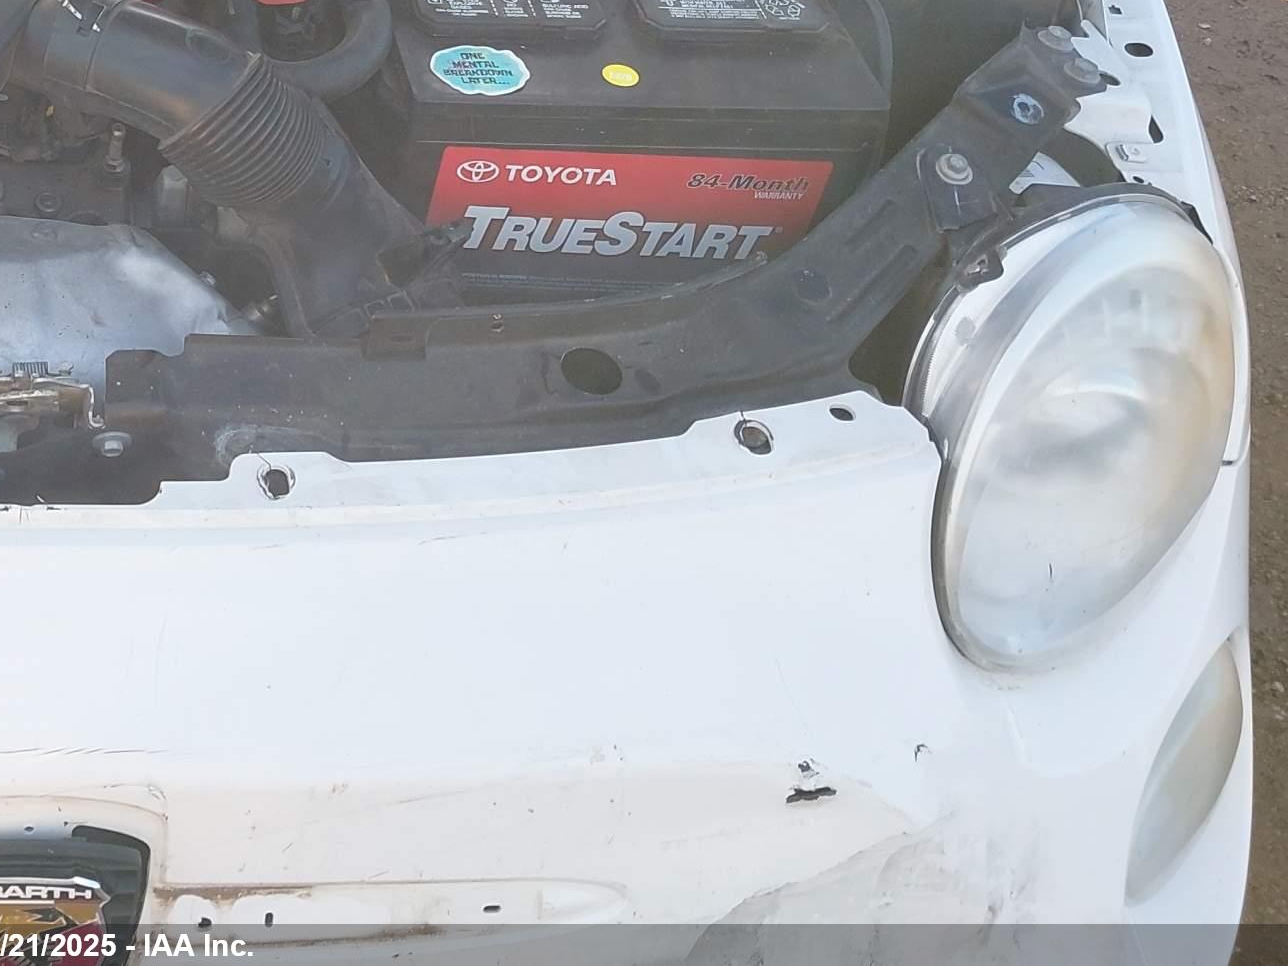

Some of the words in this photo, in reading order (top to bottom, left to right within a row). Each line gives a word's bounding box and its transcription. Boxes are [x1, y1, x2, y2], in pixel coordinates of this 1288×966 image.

[460, 52, 485, 60] ONE
[452, 61, 499, 69] MENTAL
[443, 68, 513, 77] BREAKDOWN
[505, 164, 617, 187] TOYOTA
[687, 172, 810, 193] 84-Month
[754, 191, 805, 201] WARRANTY
